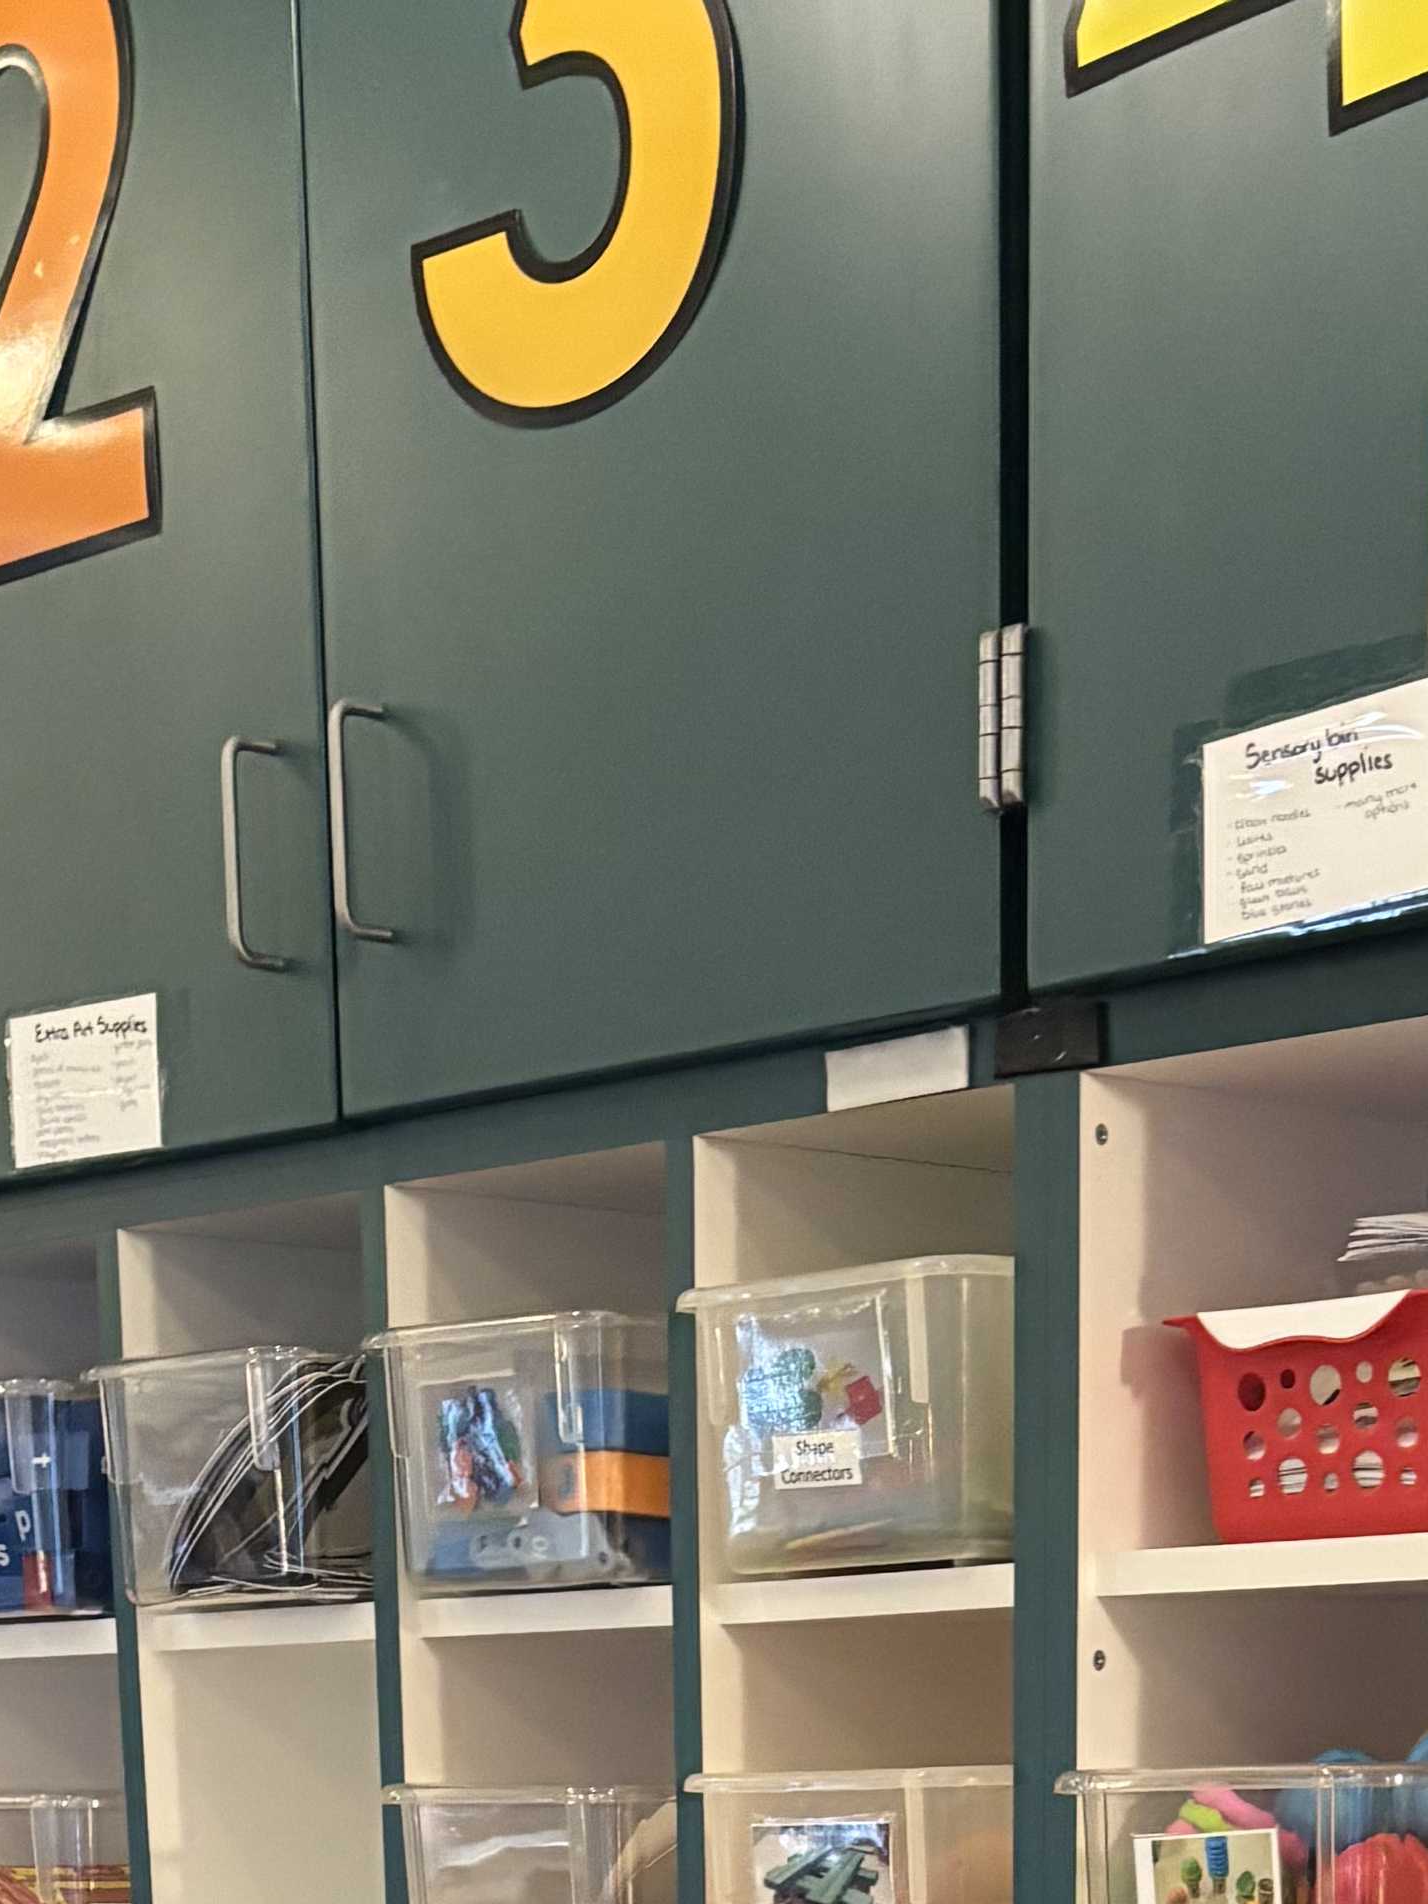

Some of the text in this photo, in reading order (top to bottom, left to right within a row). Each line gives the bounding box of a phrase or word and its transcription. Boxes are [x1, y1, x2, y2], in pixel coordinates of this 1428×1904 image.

[1246, 722, 1359, 769] Sensory bin
[1314, 746, 1393, 787] supplies
[74, 1021, 93, 1037] Art
[96, 1015, 148, 1039] Supplies
[796, 1439, 836, 1462] Shape
[782, 1463, 854, 1485] Connectors
